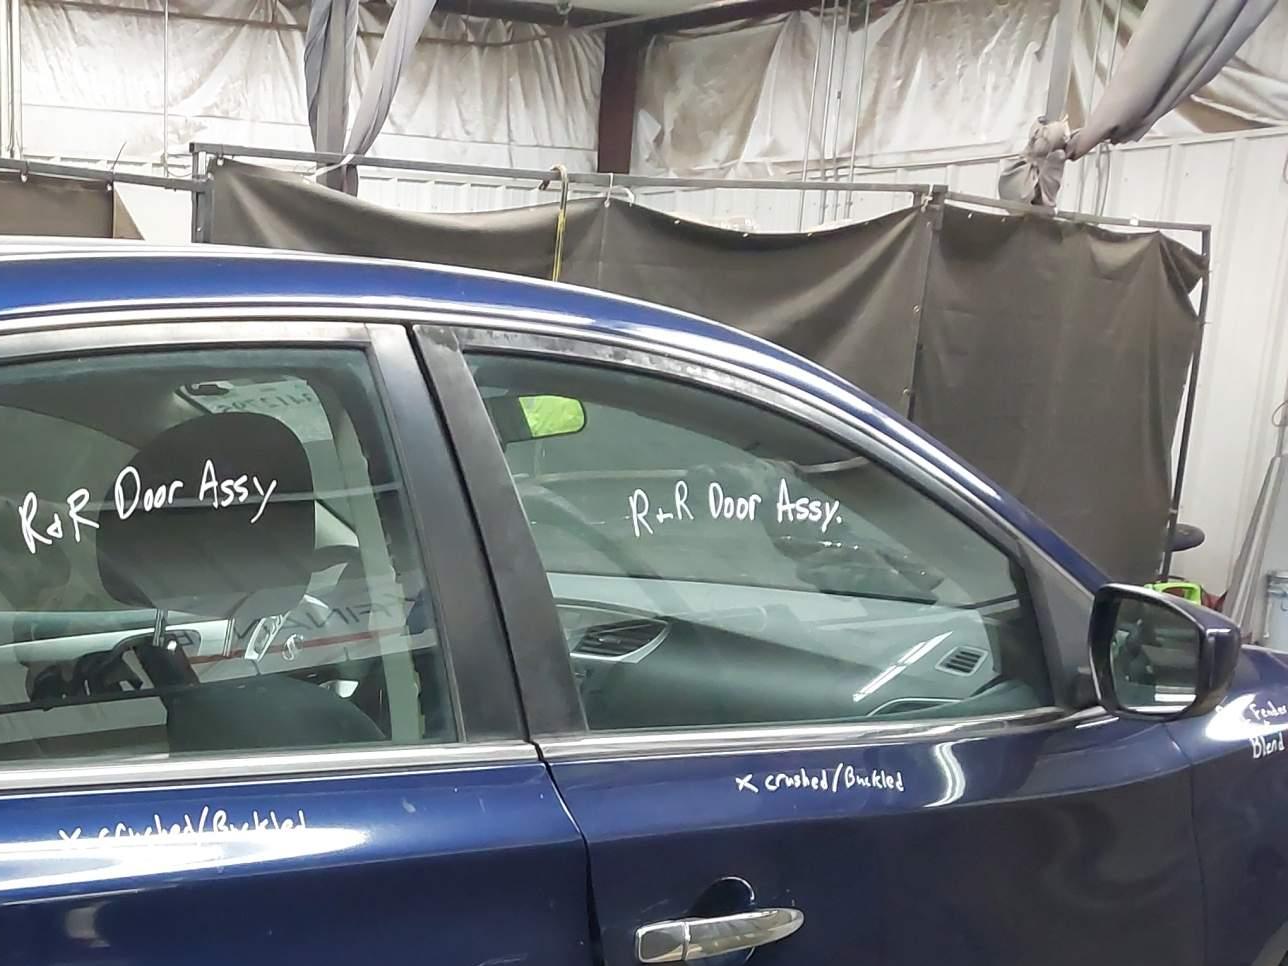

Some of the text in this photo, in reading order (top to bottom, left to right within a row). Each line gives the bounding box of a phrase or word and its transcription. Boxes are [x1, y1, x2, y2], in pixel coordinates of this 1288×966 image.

[114, 465, 184, 520] Door
[199, 459, 277, 524] Assy
[708, 482, 762, 521] Door
[1248, 730, 1285, 758] Blend
